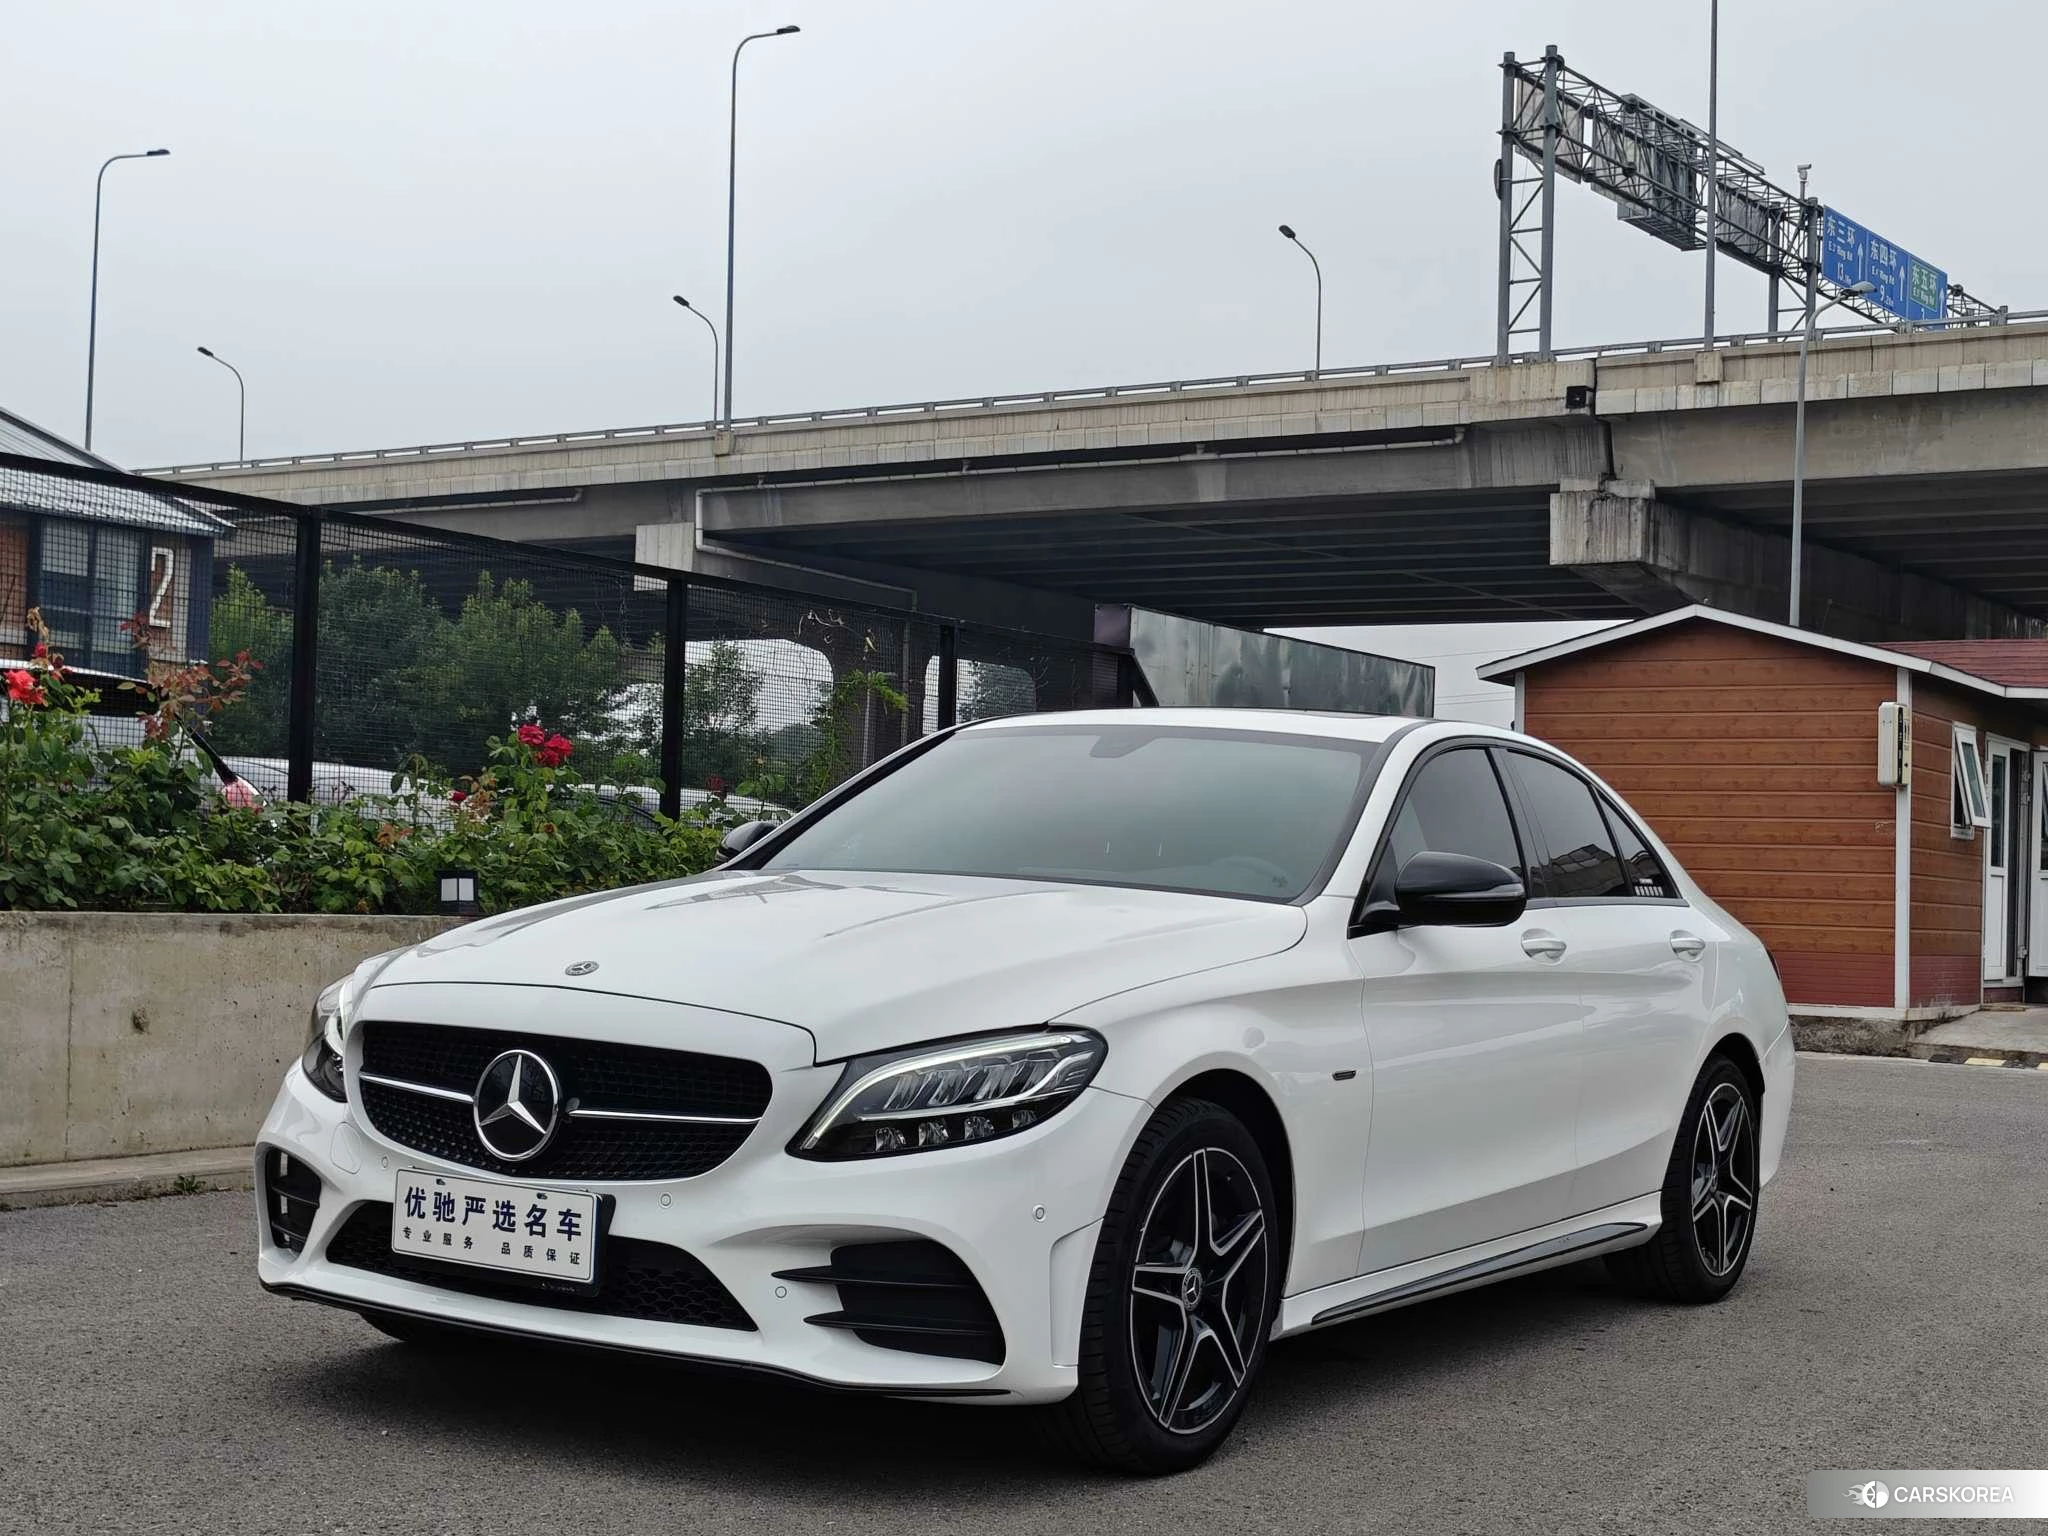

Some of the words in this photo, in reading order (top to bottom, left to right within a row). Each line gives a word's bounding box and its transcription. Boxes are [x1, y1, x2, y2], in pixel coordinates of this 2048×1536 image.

[1827, 215, 1855, 248] 东三环
[1870, 239, 1897, 270] 东四环
[1912, 264, 1937, 294] 东五环
[148, 546, 174, 628] 2
[404, 1186, 582, 1241] 优驰严选名车
[402, 1226, 474, 1250] 专业服务
[501, 1242, 581, 1266] 品质保证
